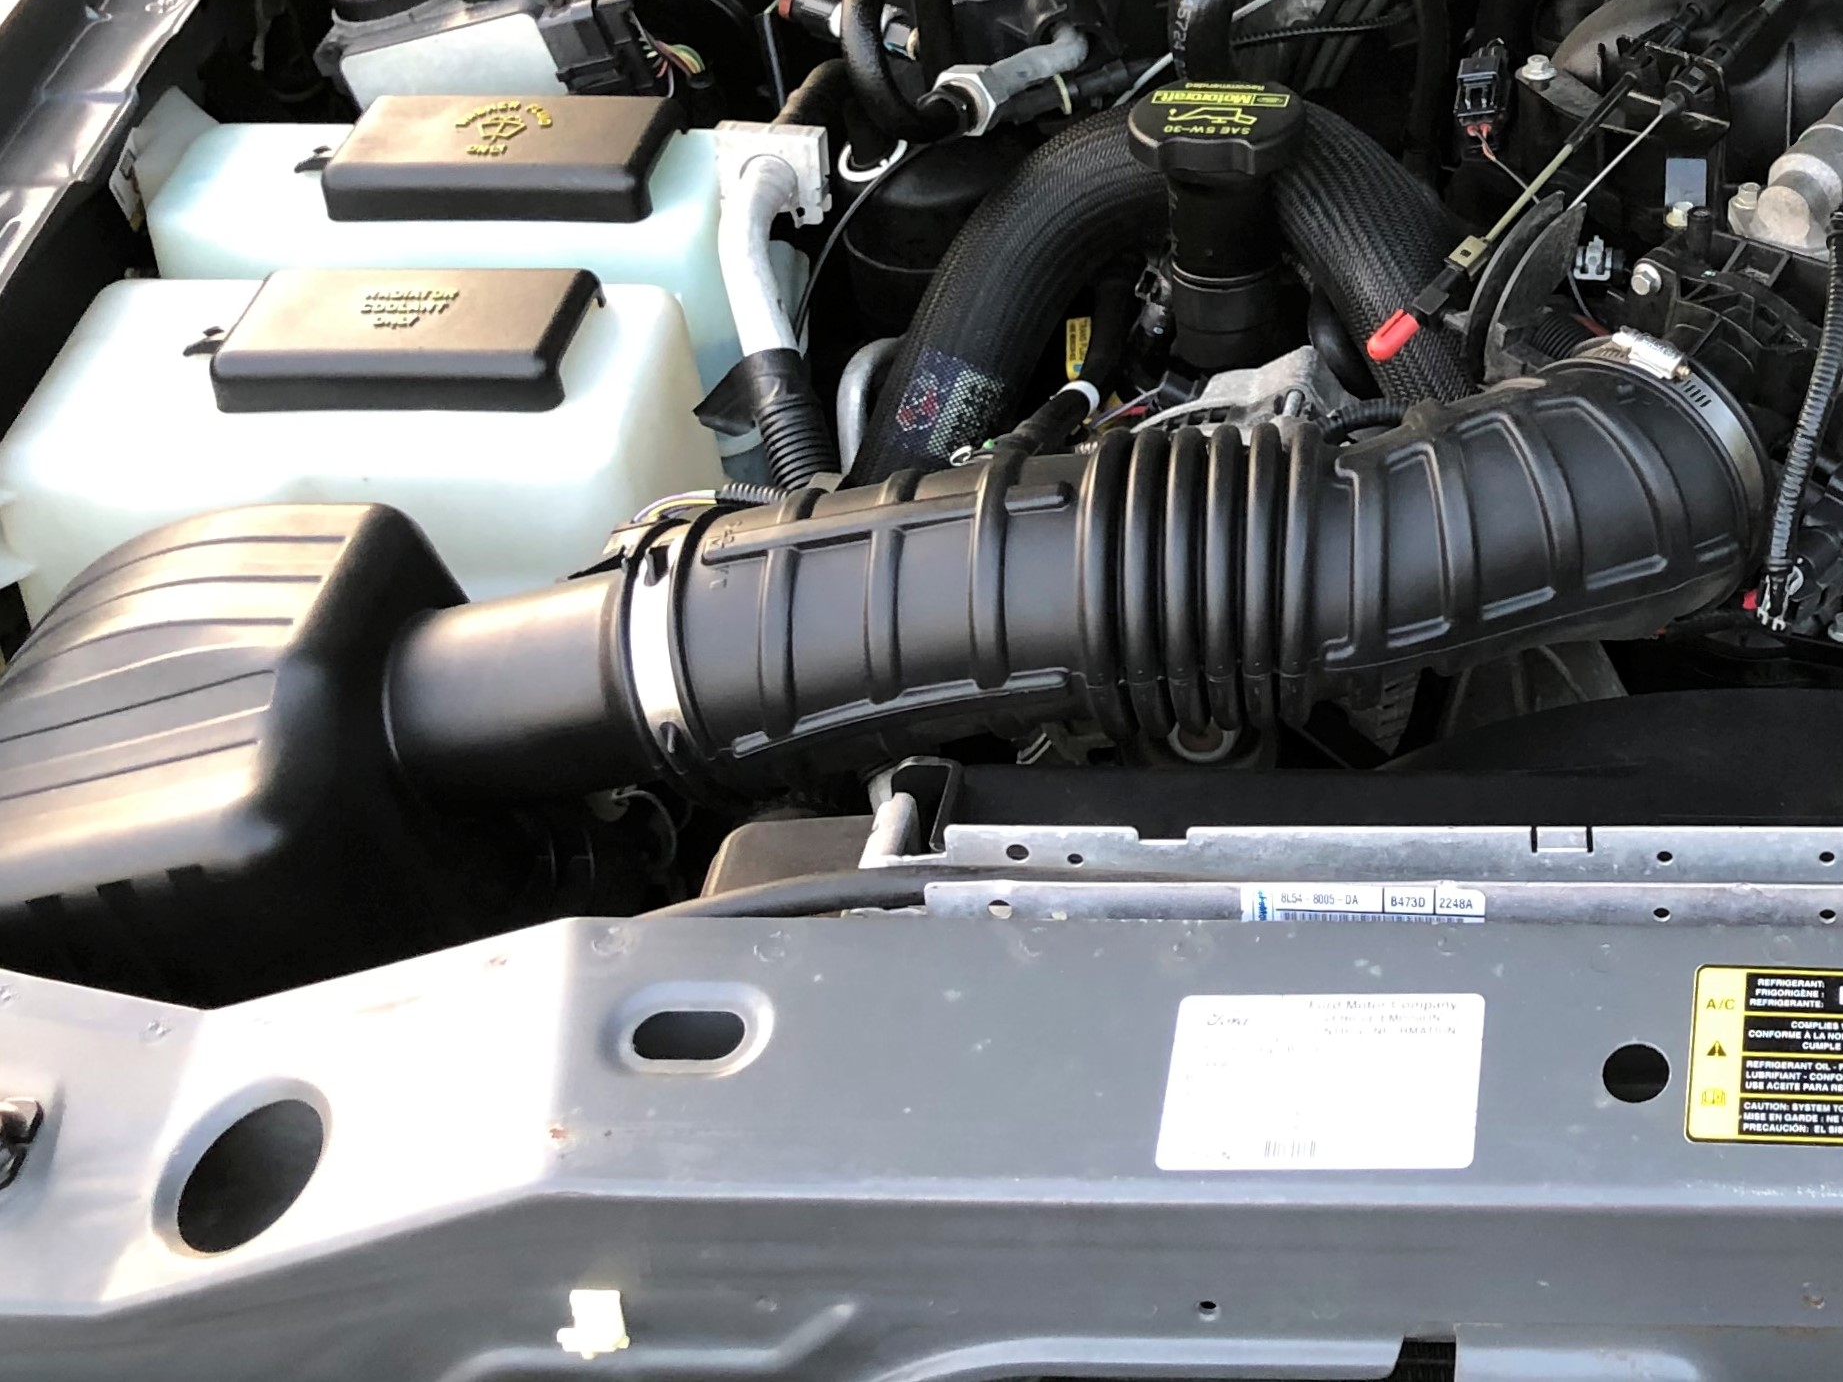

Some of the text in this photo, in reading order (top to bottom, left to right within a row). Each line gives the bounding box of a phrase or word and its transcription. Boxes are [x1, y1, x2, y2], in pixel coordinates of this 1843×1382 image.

[1159, 92, 1252, 104] Motorcraft
[1163, 124, 1251, 135] SAE 5W-30
[1312, 893, 1335, 905] 8005
[1439, 897, 1473, 910] 2248A
[1706, 999, 1734, 1010] A/C
[1791, 1021, 1839, 1031] COMPLIES
[1748, 1029, 1802, 1039] CONFORME
[1813, 1032, 1826, 1040] LA
[1802, 1041, 1841, 1051] CUMPLE
[1746, 1060, 1813, 1070] REFRIGERANT
[1815, 1062, 1831, 1071] OIL
[1745, 1071, 1802, 1080] LUBRIFIANT
[1745, 1081, 1765, 1090] USE
[1766, 1081, 1800, 1091] ACEITE
[1803, 1083, 1829, 1092] PARA
[1743, 1101, 1790, 1111] CAUTION:
[1792, 1103, 1831, 1112] SYSTEM
[1813, 1125, 1826, 1134] EL
